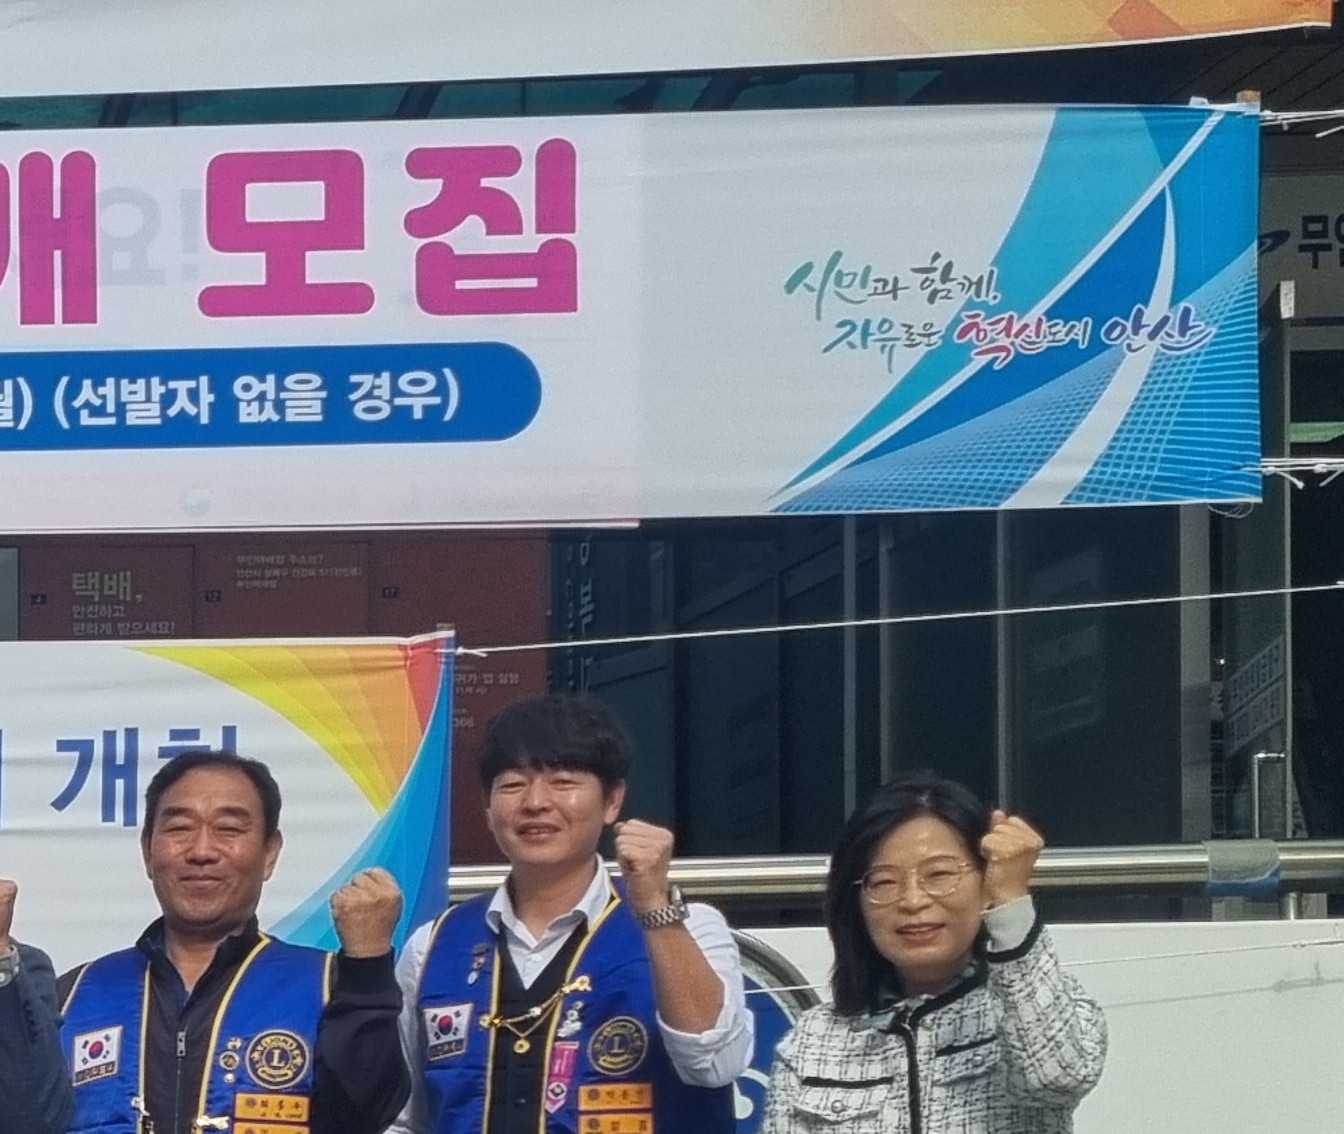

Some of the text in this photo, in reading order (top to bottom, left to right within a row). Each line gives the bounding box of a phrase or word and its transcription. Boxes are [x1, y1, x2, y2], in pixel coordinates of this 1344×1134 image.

[198, 137, 579, 318] 모집
[783, 250, 910, 321] 시민과
[822, 304, 1215, 374] 자유로운 혁신도시 안산
[52, 372, 215, 430] (선발자
[233, 371, 322, 425] 없을
[348, 367, 461, 422] 경우)
[72, 571, 143, 603] 택배,
